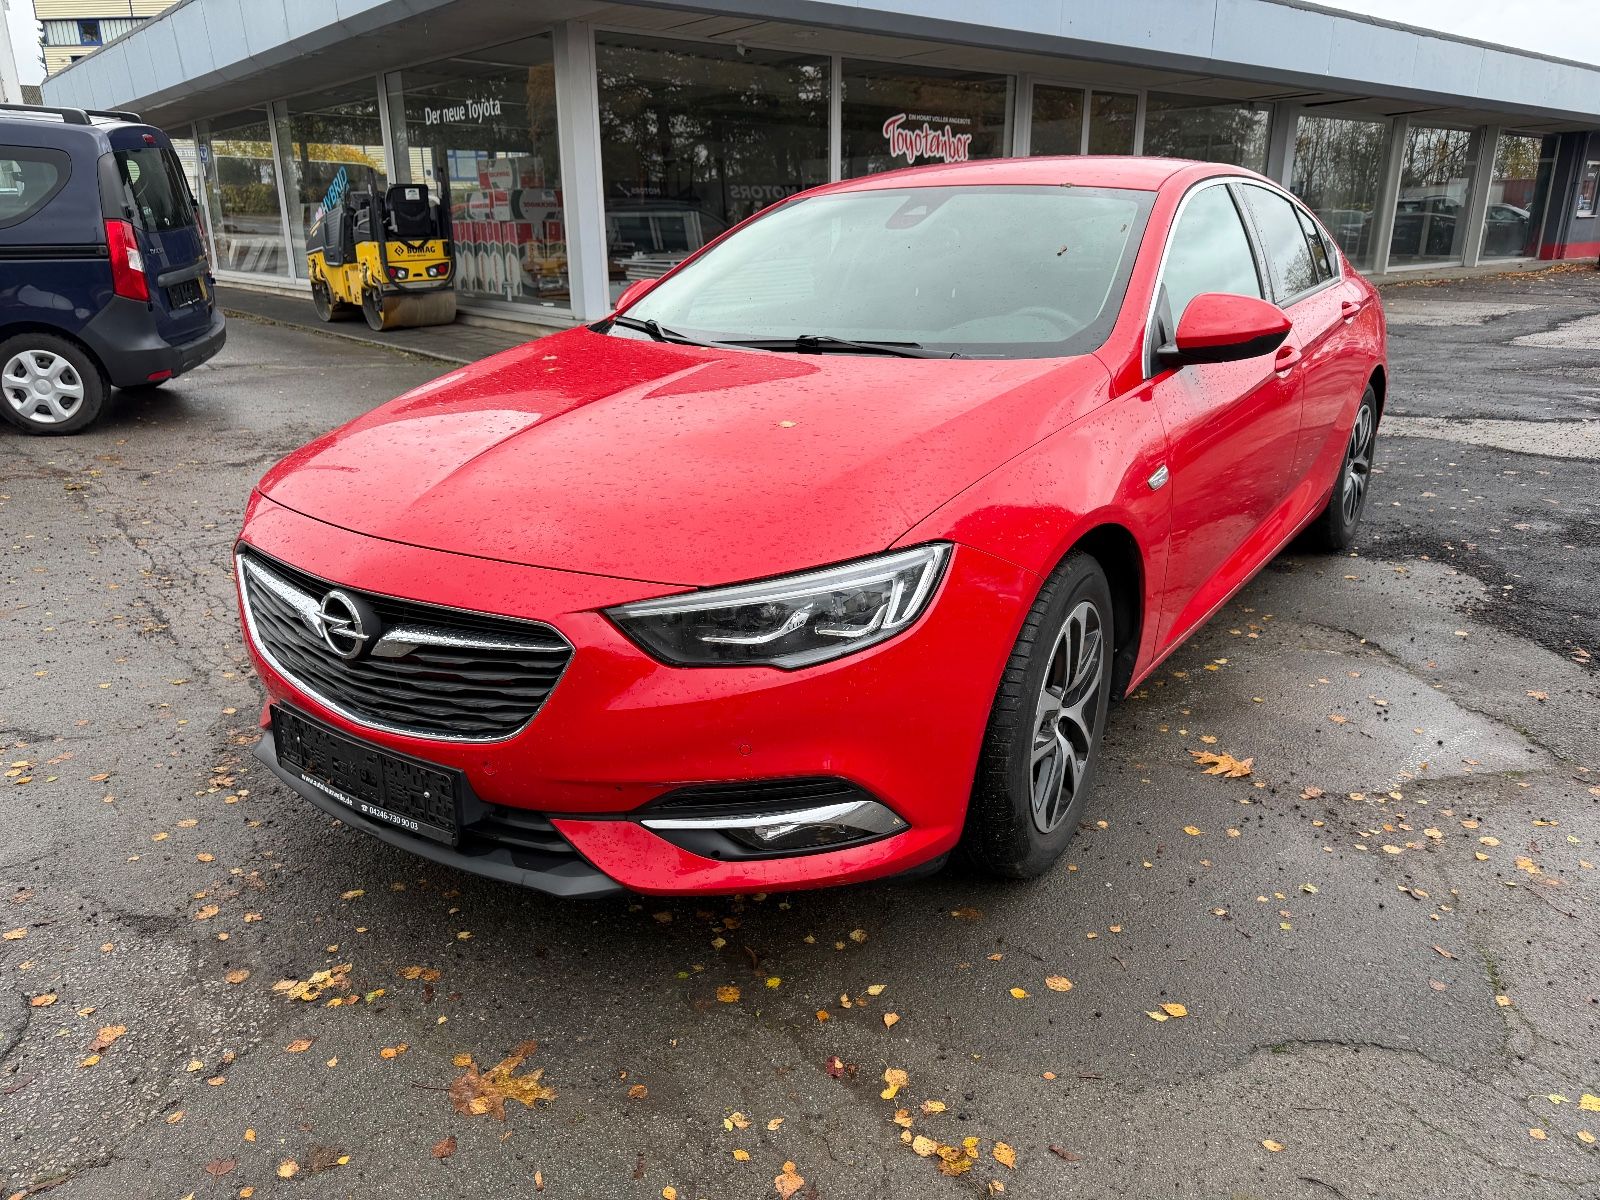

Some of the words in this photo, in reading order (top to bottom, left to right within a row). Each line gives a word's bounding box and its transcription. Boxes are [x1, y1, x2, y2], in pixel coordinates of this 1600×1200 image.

[425, 107, 440, 125] Der
[442, 105, 465, 123] neue
[466, 97, 501, 124] Toyota
[908, 113, 916, 121] EIN
[916, 114, 931, 122] MONAT
[932, 115, 948, 123] VOLLER
[948, 117, 971, 125] ANGEBOTE
[883, 113, 972, 164] Toyotember
[321, 165, 348, 214] HYBRID
[369, 806, 400, 824] 04246-730
[401, 820, 410, 828] 90
[410, 823, 419, 831] 03
